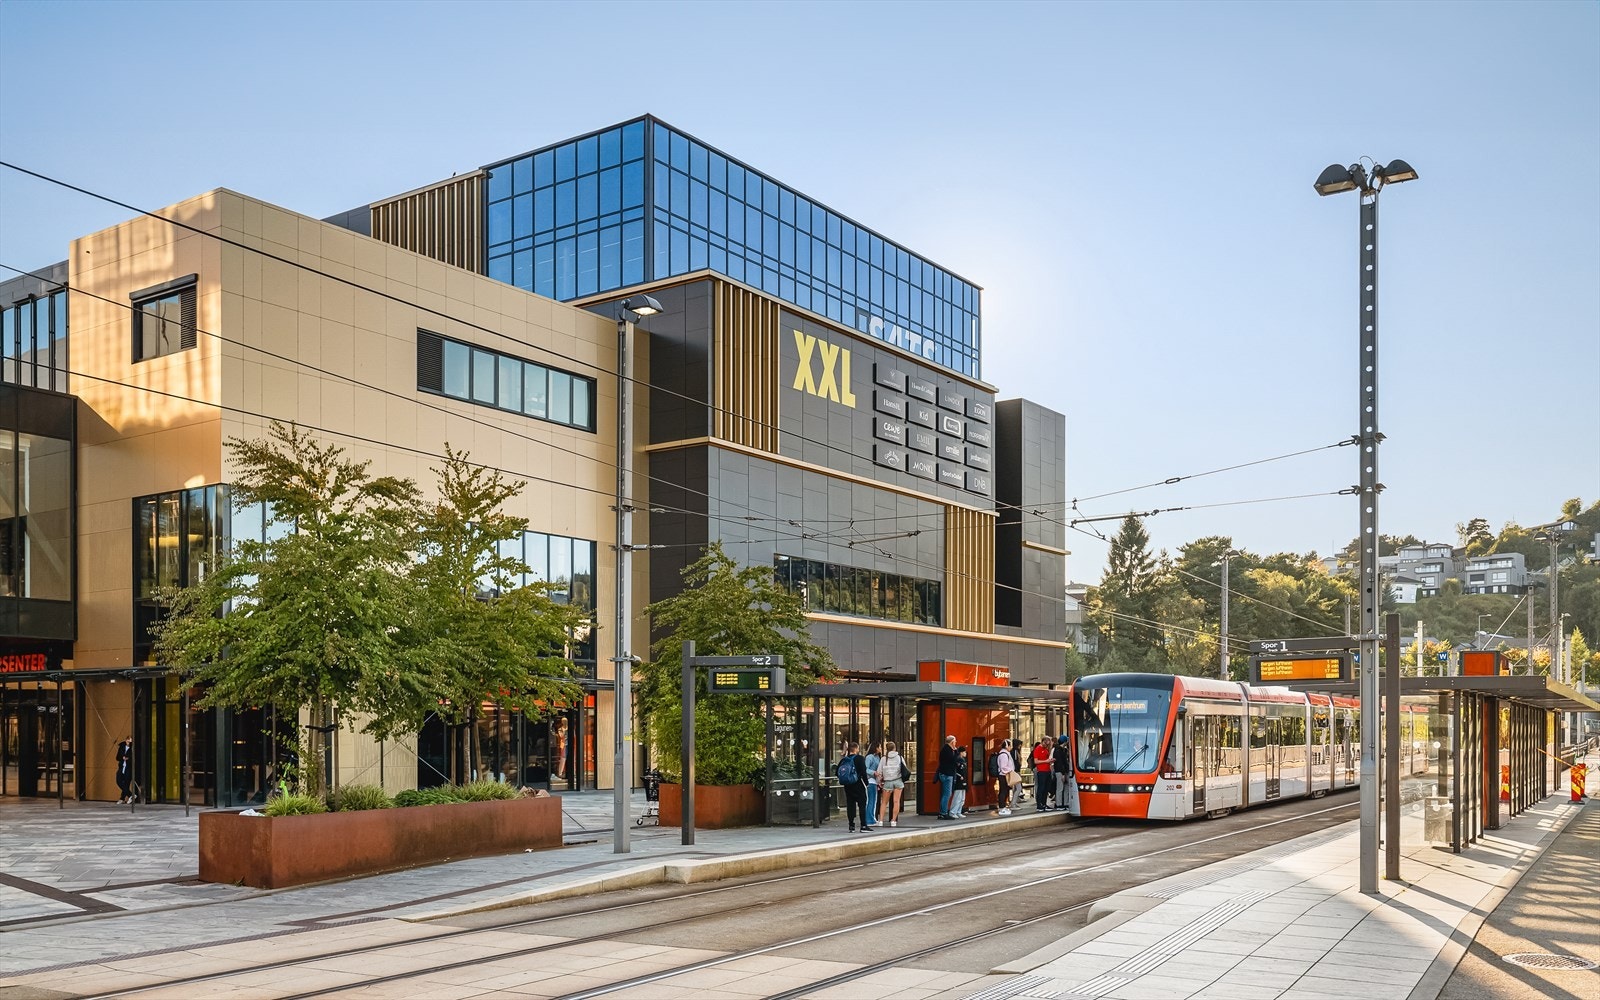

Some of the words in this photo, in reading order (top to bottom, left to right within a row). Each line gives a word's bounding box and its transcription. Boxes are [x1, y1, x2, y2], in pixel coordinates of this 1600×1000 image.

[793, 329, 856, 409] XXL
[919, 410, 929, 421] Kid
[1261, 642, 1278, 650] Spor
[1280, 641, 1289, 652] 1
[765, 656, 771, 665] 2
